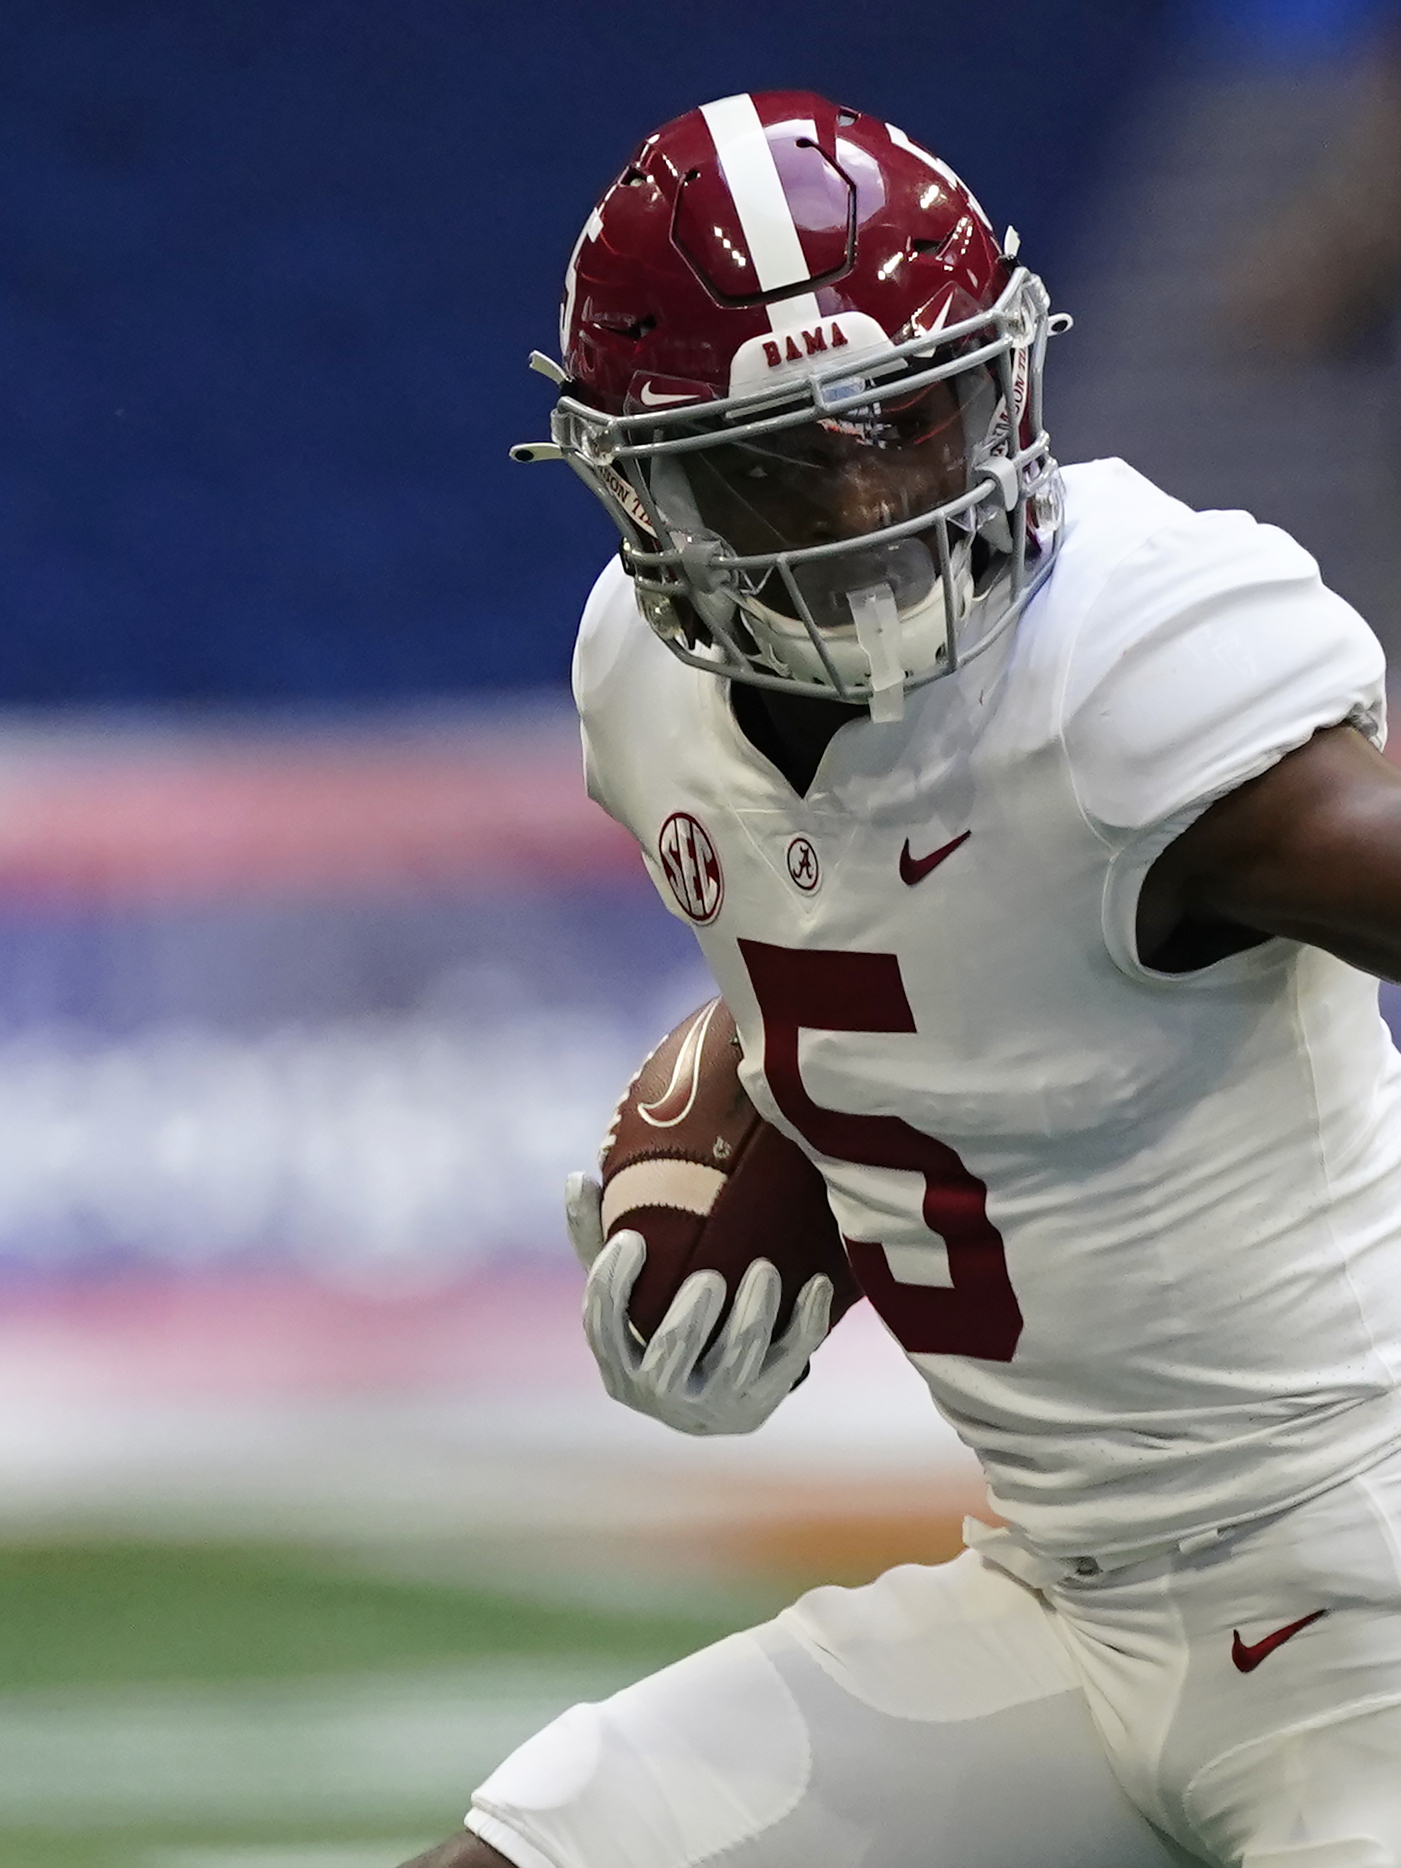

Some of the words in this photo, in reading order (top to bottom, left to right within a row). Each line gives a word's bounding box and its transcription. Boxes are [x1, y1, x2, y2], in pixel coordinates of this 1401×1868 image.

[762, 321, 848, 367] BAMA
[661, 818, 720, 917] SEC
[793, 846, 813, 879] A
[737, 937, 1024, 1363] 5
